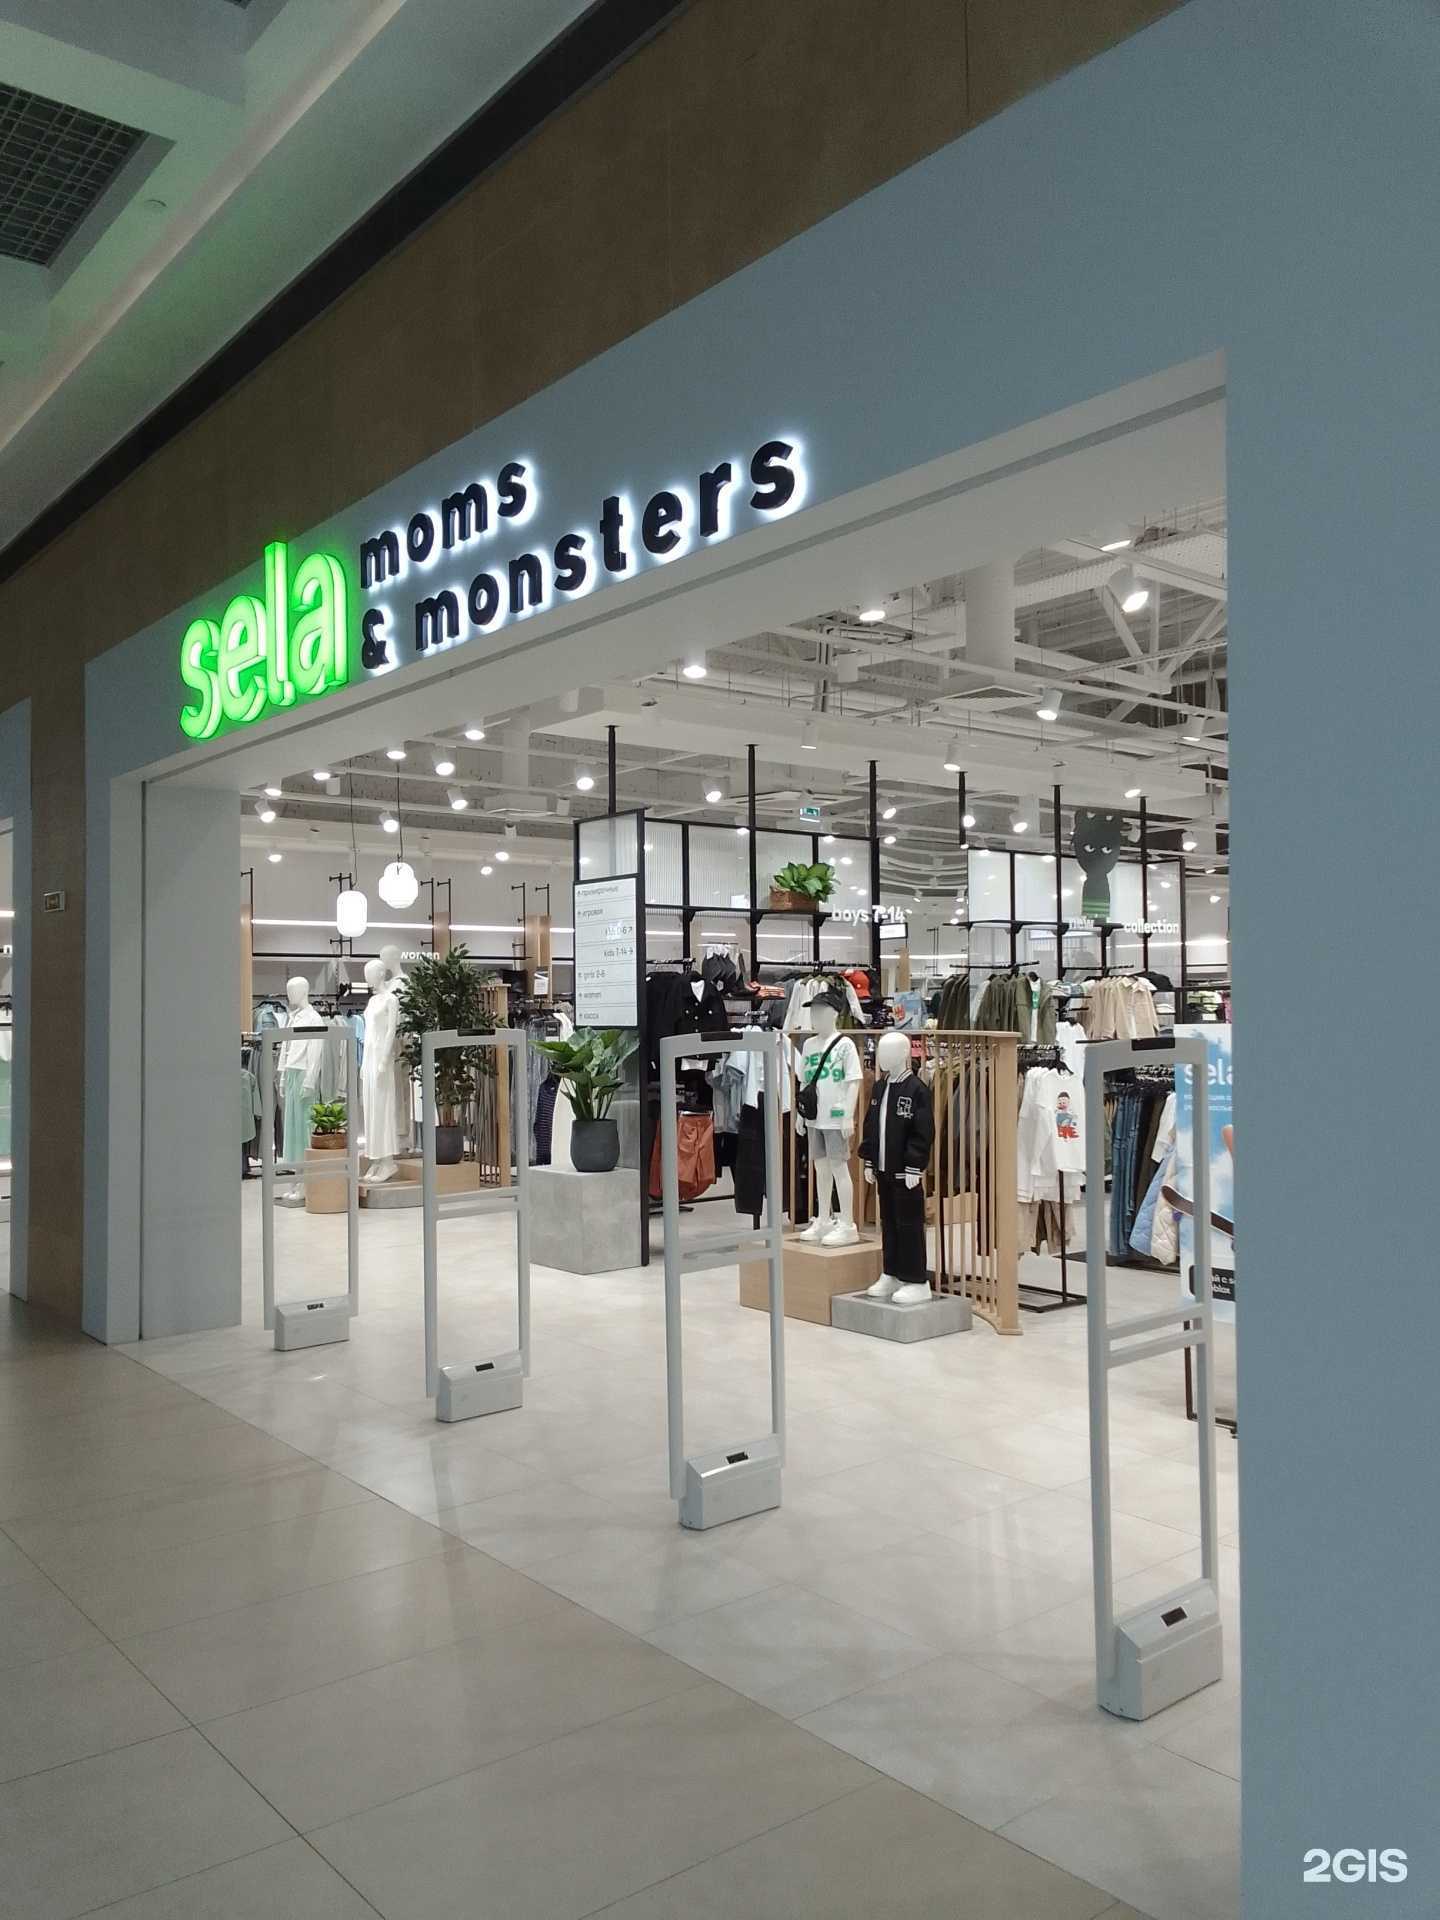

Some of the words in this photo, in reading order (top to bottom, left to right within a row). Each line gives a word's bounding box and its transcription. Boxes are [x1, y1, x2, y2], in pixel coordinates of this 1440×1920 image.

[360, 461, 528, 589] moms
[361, 608, 390, 670] &
[415, 440, 796, 652] monsters
[179, 540, 349, 741] sela
[831, 903, 870, 927] boys
[872, 904, 906, 924] 7-14
[1123, 917, 1180, 934] collection
